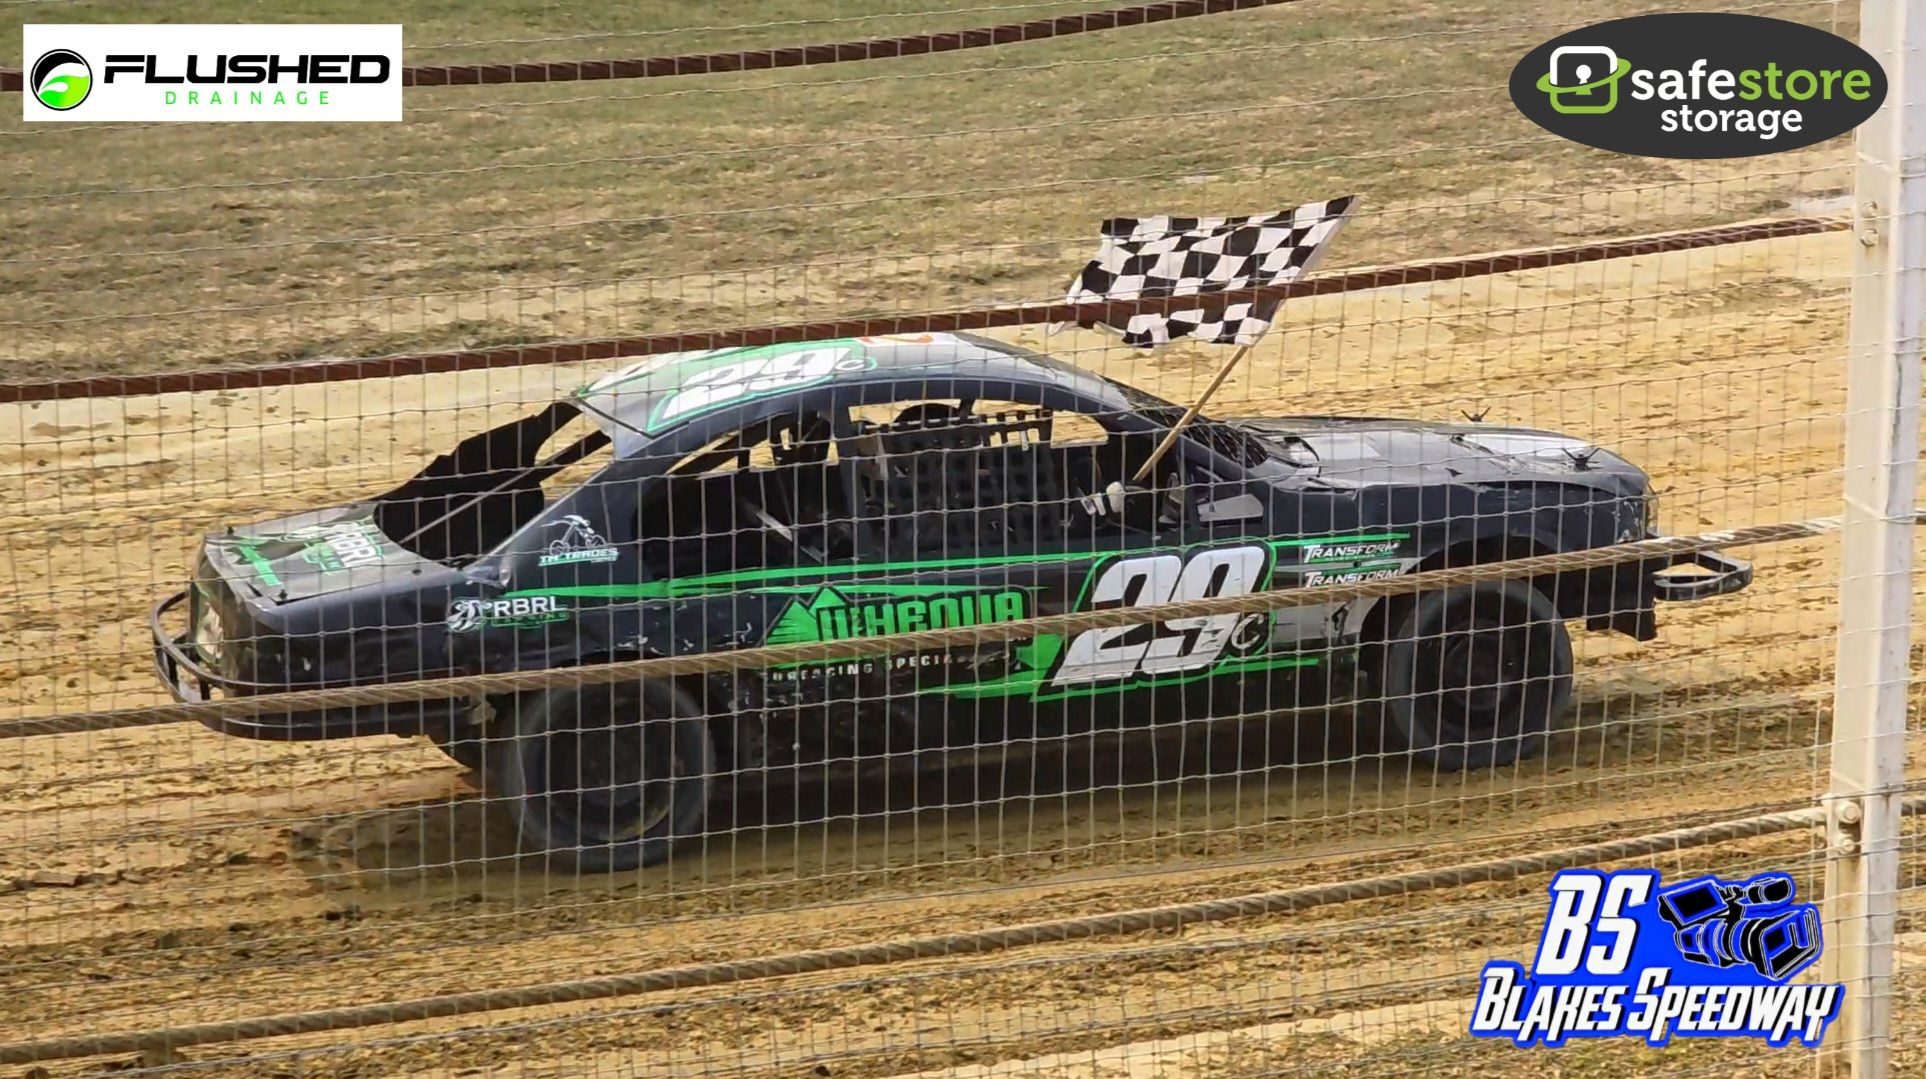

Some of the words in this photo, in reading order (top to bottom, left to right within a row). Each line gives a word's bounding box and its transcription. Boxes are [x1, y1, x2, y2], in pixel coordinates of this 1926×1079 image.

[1303, 543, 1399, 563] TRANSFORM
[1305, 569, 1399, 588] TRANSFORM
[494, 596, 567, 617] RBRL
[1051, 546, 1264, 687] 29
